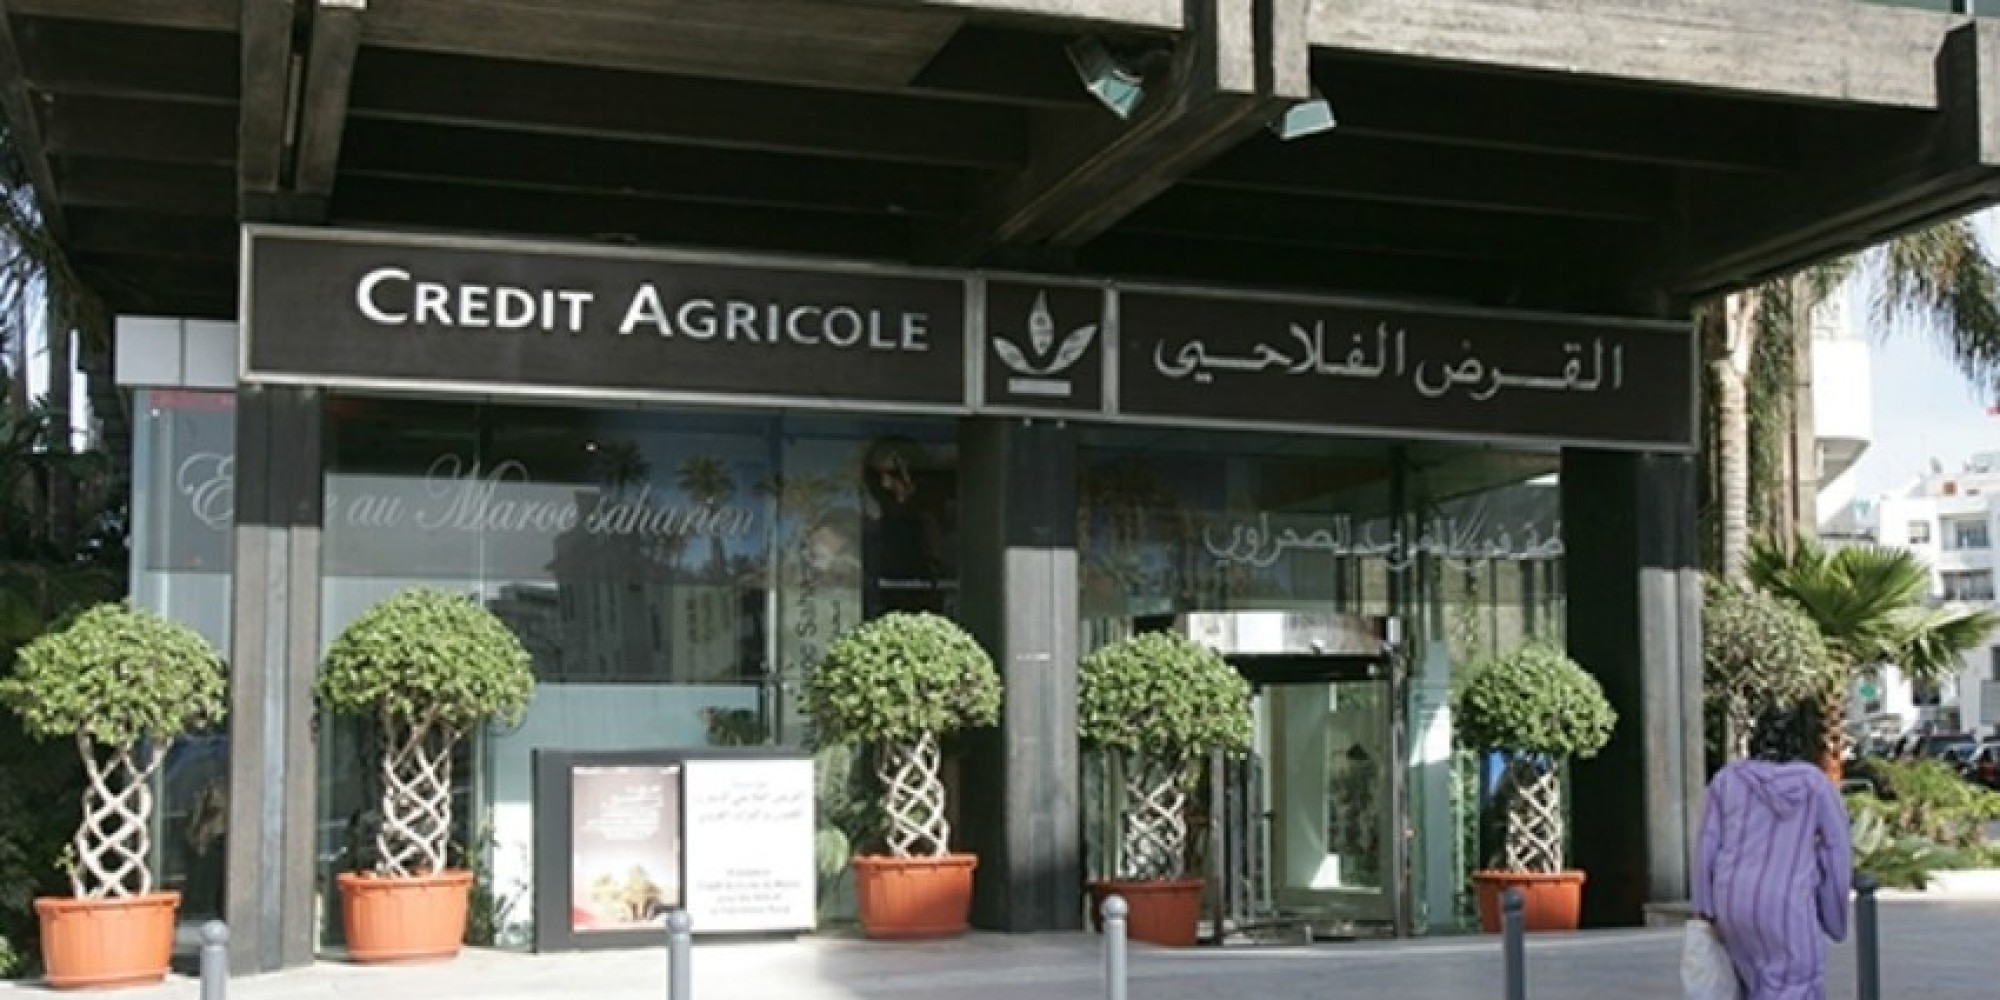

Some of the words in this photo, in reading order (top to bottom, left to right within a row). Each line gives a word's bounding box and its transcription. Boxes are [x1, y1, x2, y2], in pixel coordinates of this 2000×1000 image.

[356, 267, 594, 333] CREDIT
[619, 282, 930, 353] AGRICOLE
[346, 495, 402, 530] au
[413, 455, 578, 532] Maroc
[582, 484, 757, 538] saharien
